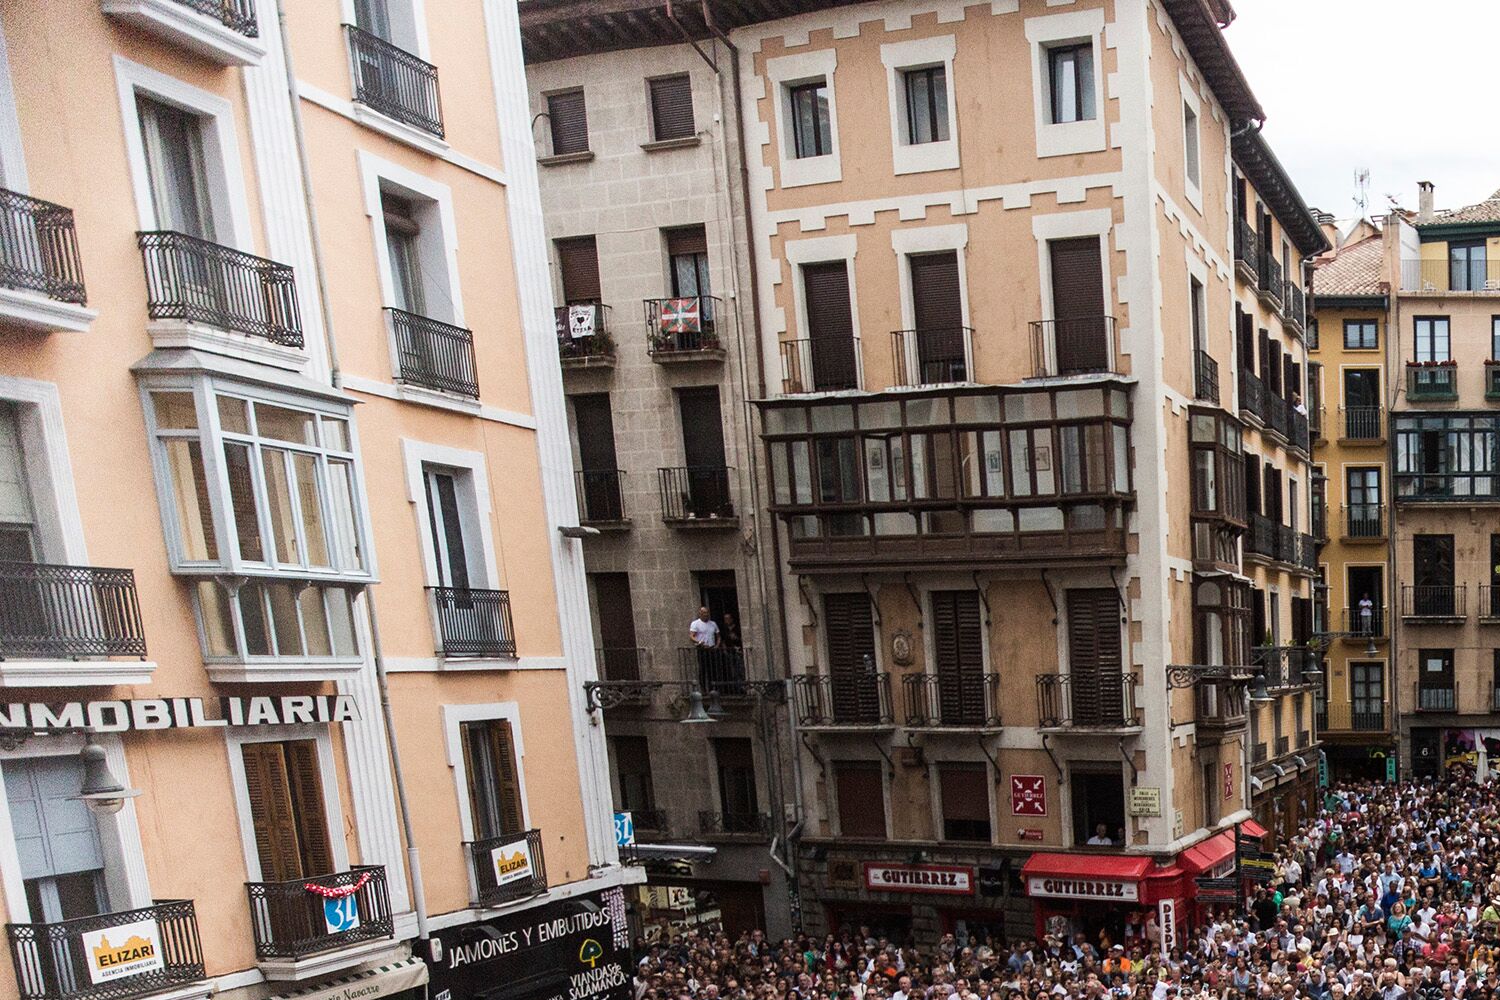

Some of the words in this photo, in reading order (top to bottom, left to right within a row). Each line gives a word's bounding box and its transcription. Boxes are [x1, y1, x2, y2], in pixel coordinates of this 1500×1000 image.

[500, 857, 528, 874] ELIZARI
[882, 870, 957, 886] GUTIERREZ
[1043, 879, 1124, 897] GUTIERREZ
[450, 932, 519, 968] JAMONES
[523, 926, 534, 946] Y
[539, 907, 612, 943] EMBUTIDOS
[99, 945, 155, 966] ELIZARI
[343, 984, 380, 1000] Navarro
[569, 971, 627, 1000] SALAMANCA
